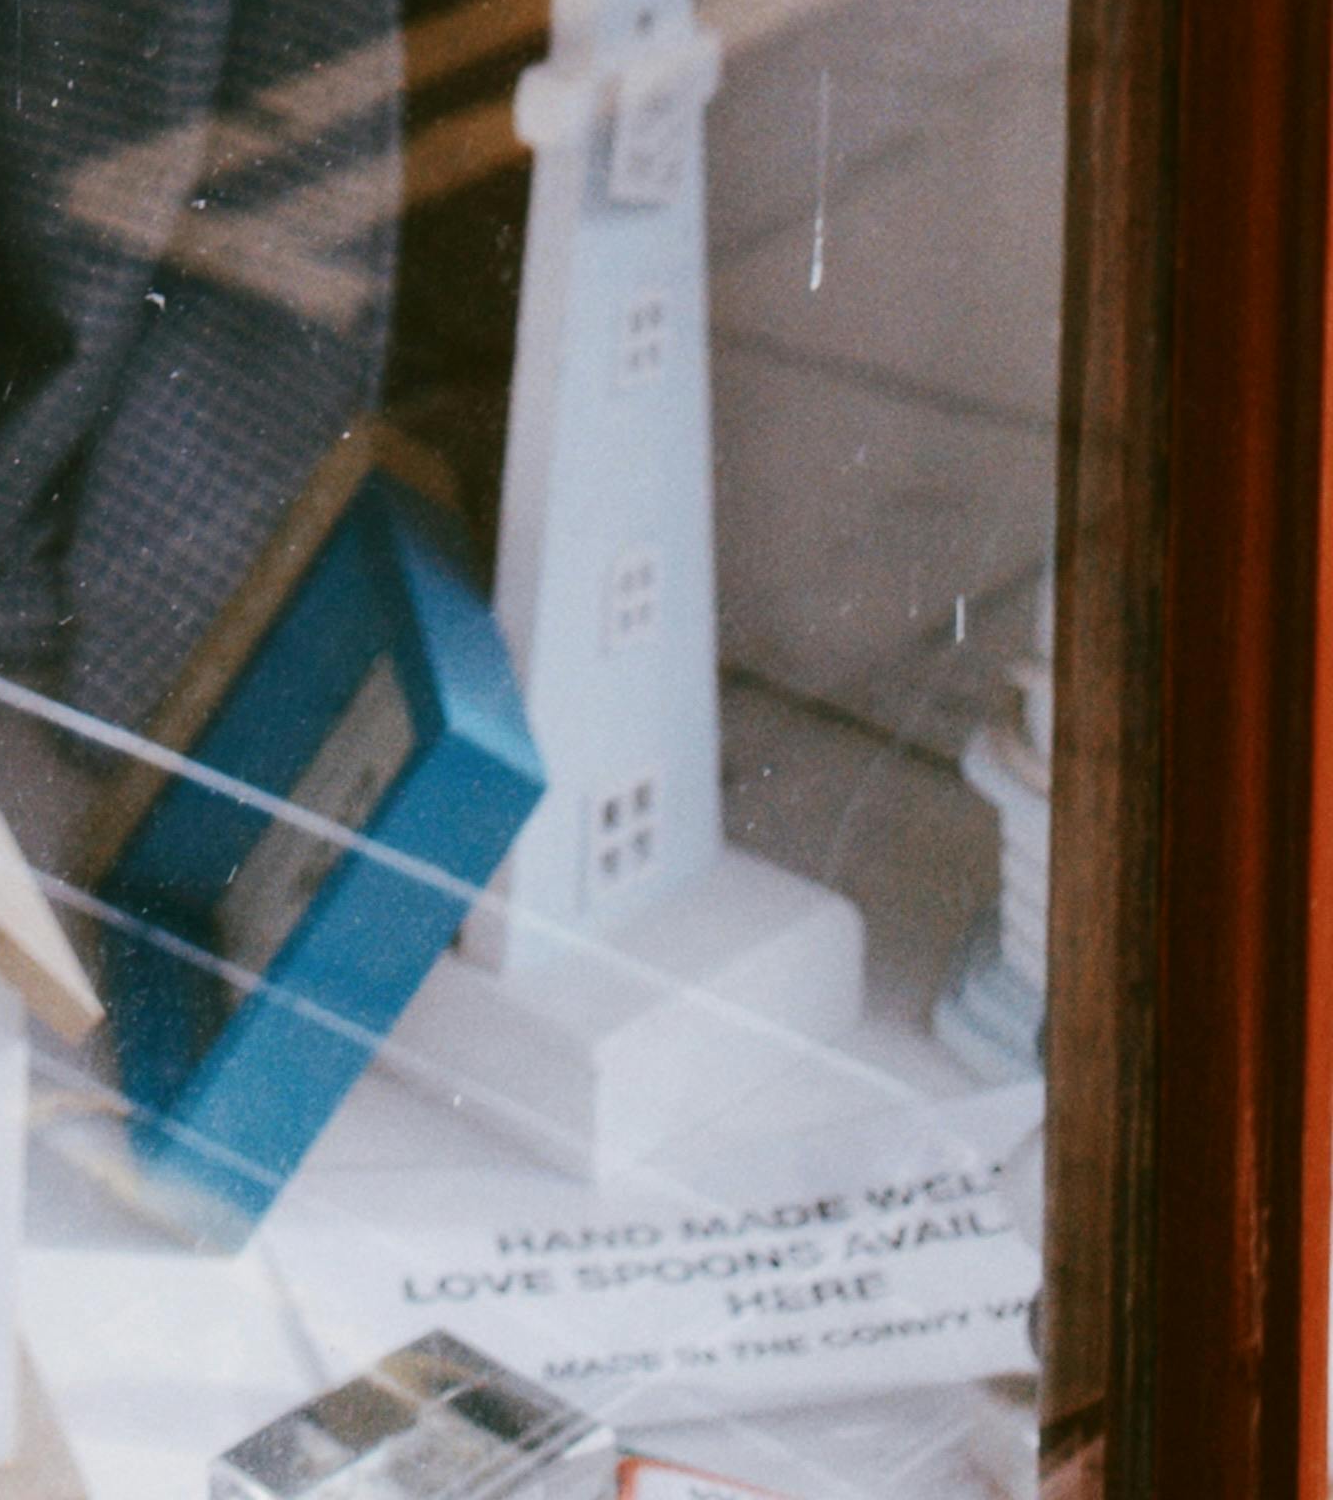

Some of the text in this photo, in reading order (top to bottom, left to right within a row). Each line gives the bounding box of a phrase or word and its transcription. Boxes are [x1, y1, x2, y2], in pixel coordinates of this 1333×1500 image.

[495, 1164, 1003, 1254] HAND MADE WEL
[402, 1268, 556, 1304] LOVE
[576, 1242, 823, 1290] SPOONS
[726, 1272, 884, 1316] HERE
[543, 1350, 662, 1382] MADE
[730, 1334, 810, 1361] THE
